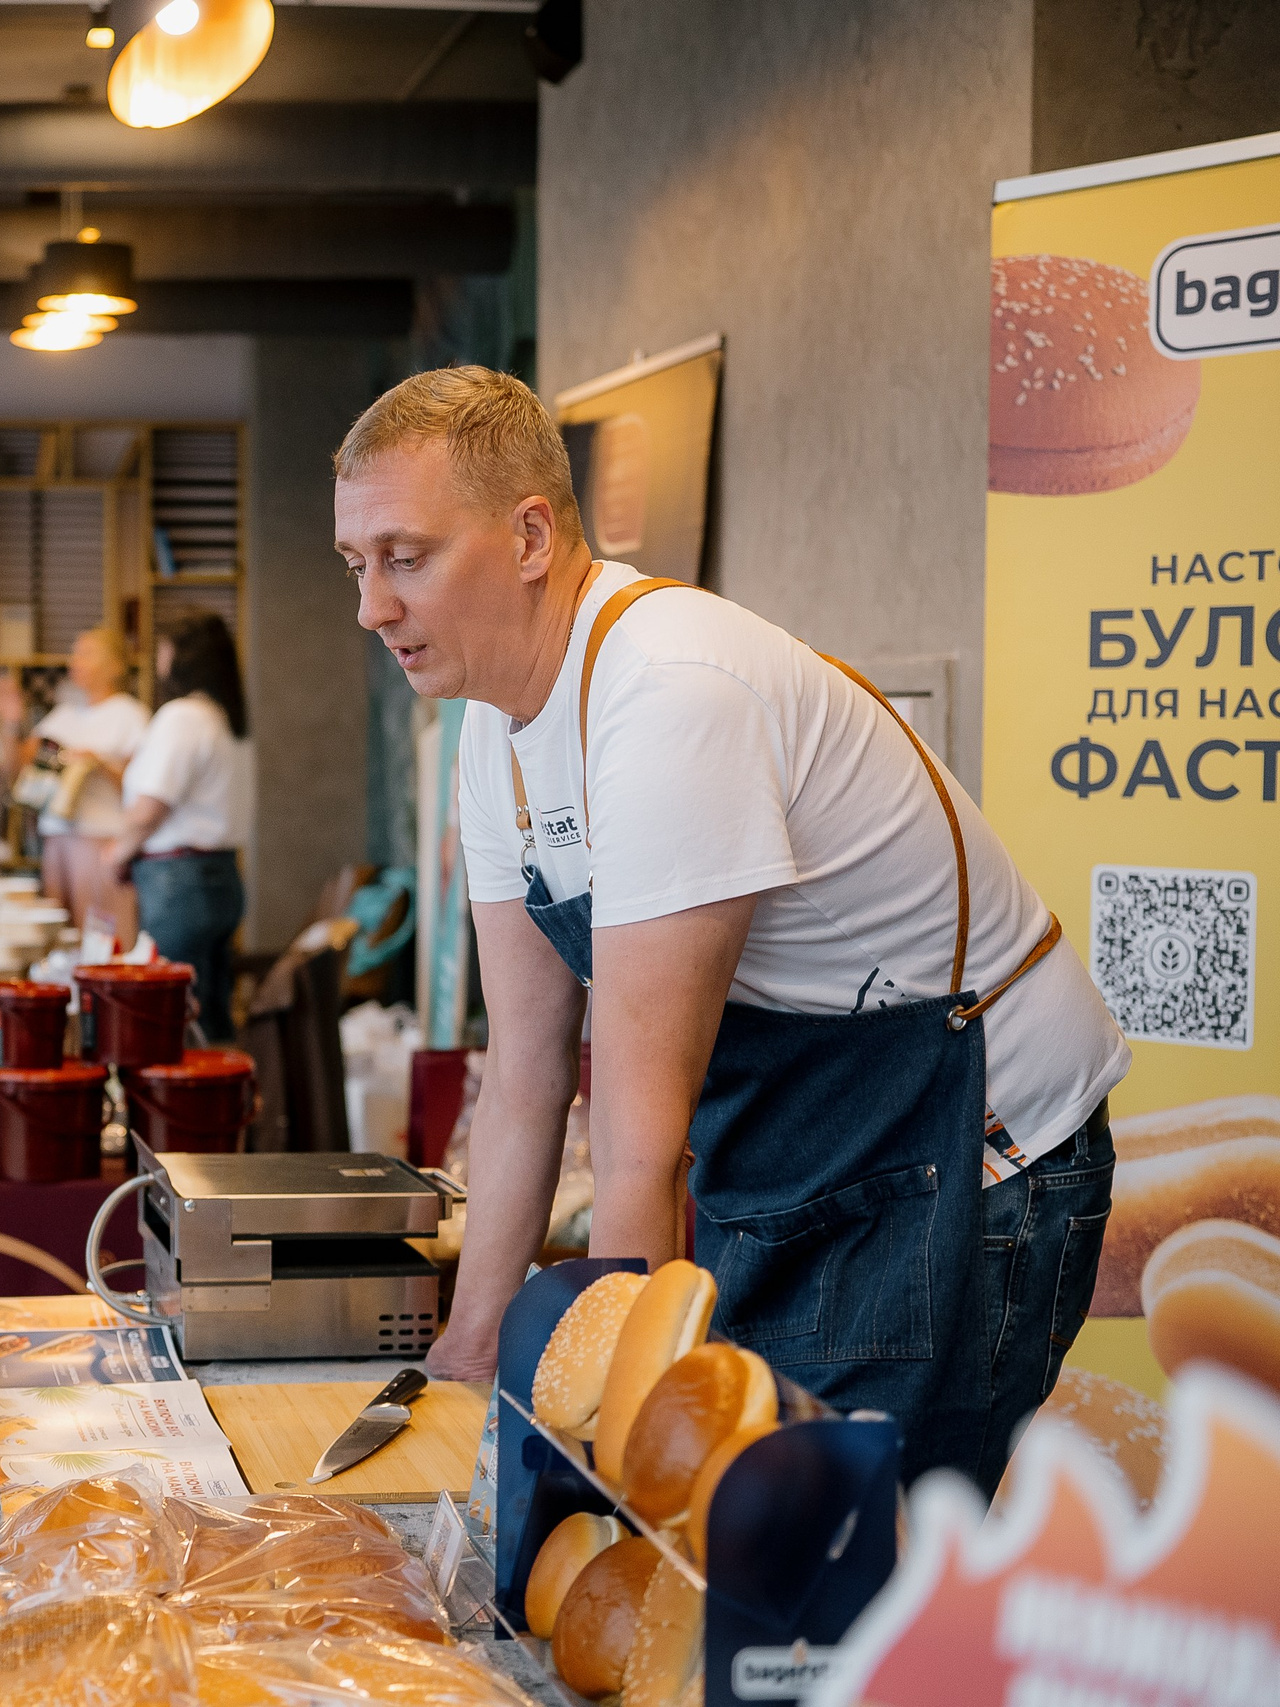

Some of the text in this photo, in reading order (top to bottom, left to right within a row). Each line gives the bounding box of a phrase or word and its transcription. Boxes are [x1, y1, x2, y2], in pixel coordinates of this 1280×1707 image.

[1151, 550, 1280, 585] НАСТ
[1087, 689, 1179, 724] ДЛЯ
[136, 1400, 150, 1409] НА
[154, 1399, 176, 1425] ВКЛЮЧИ
[161, 1462, 176, 1474] НА
[179, 1461, 204, 1495] ВКЛЮЧИ
